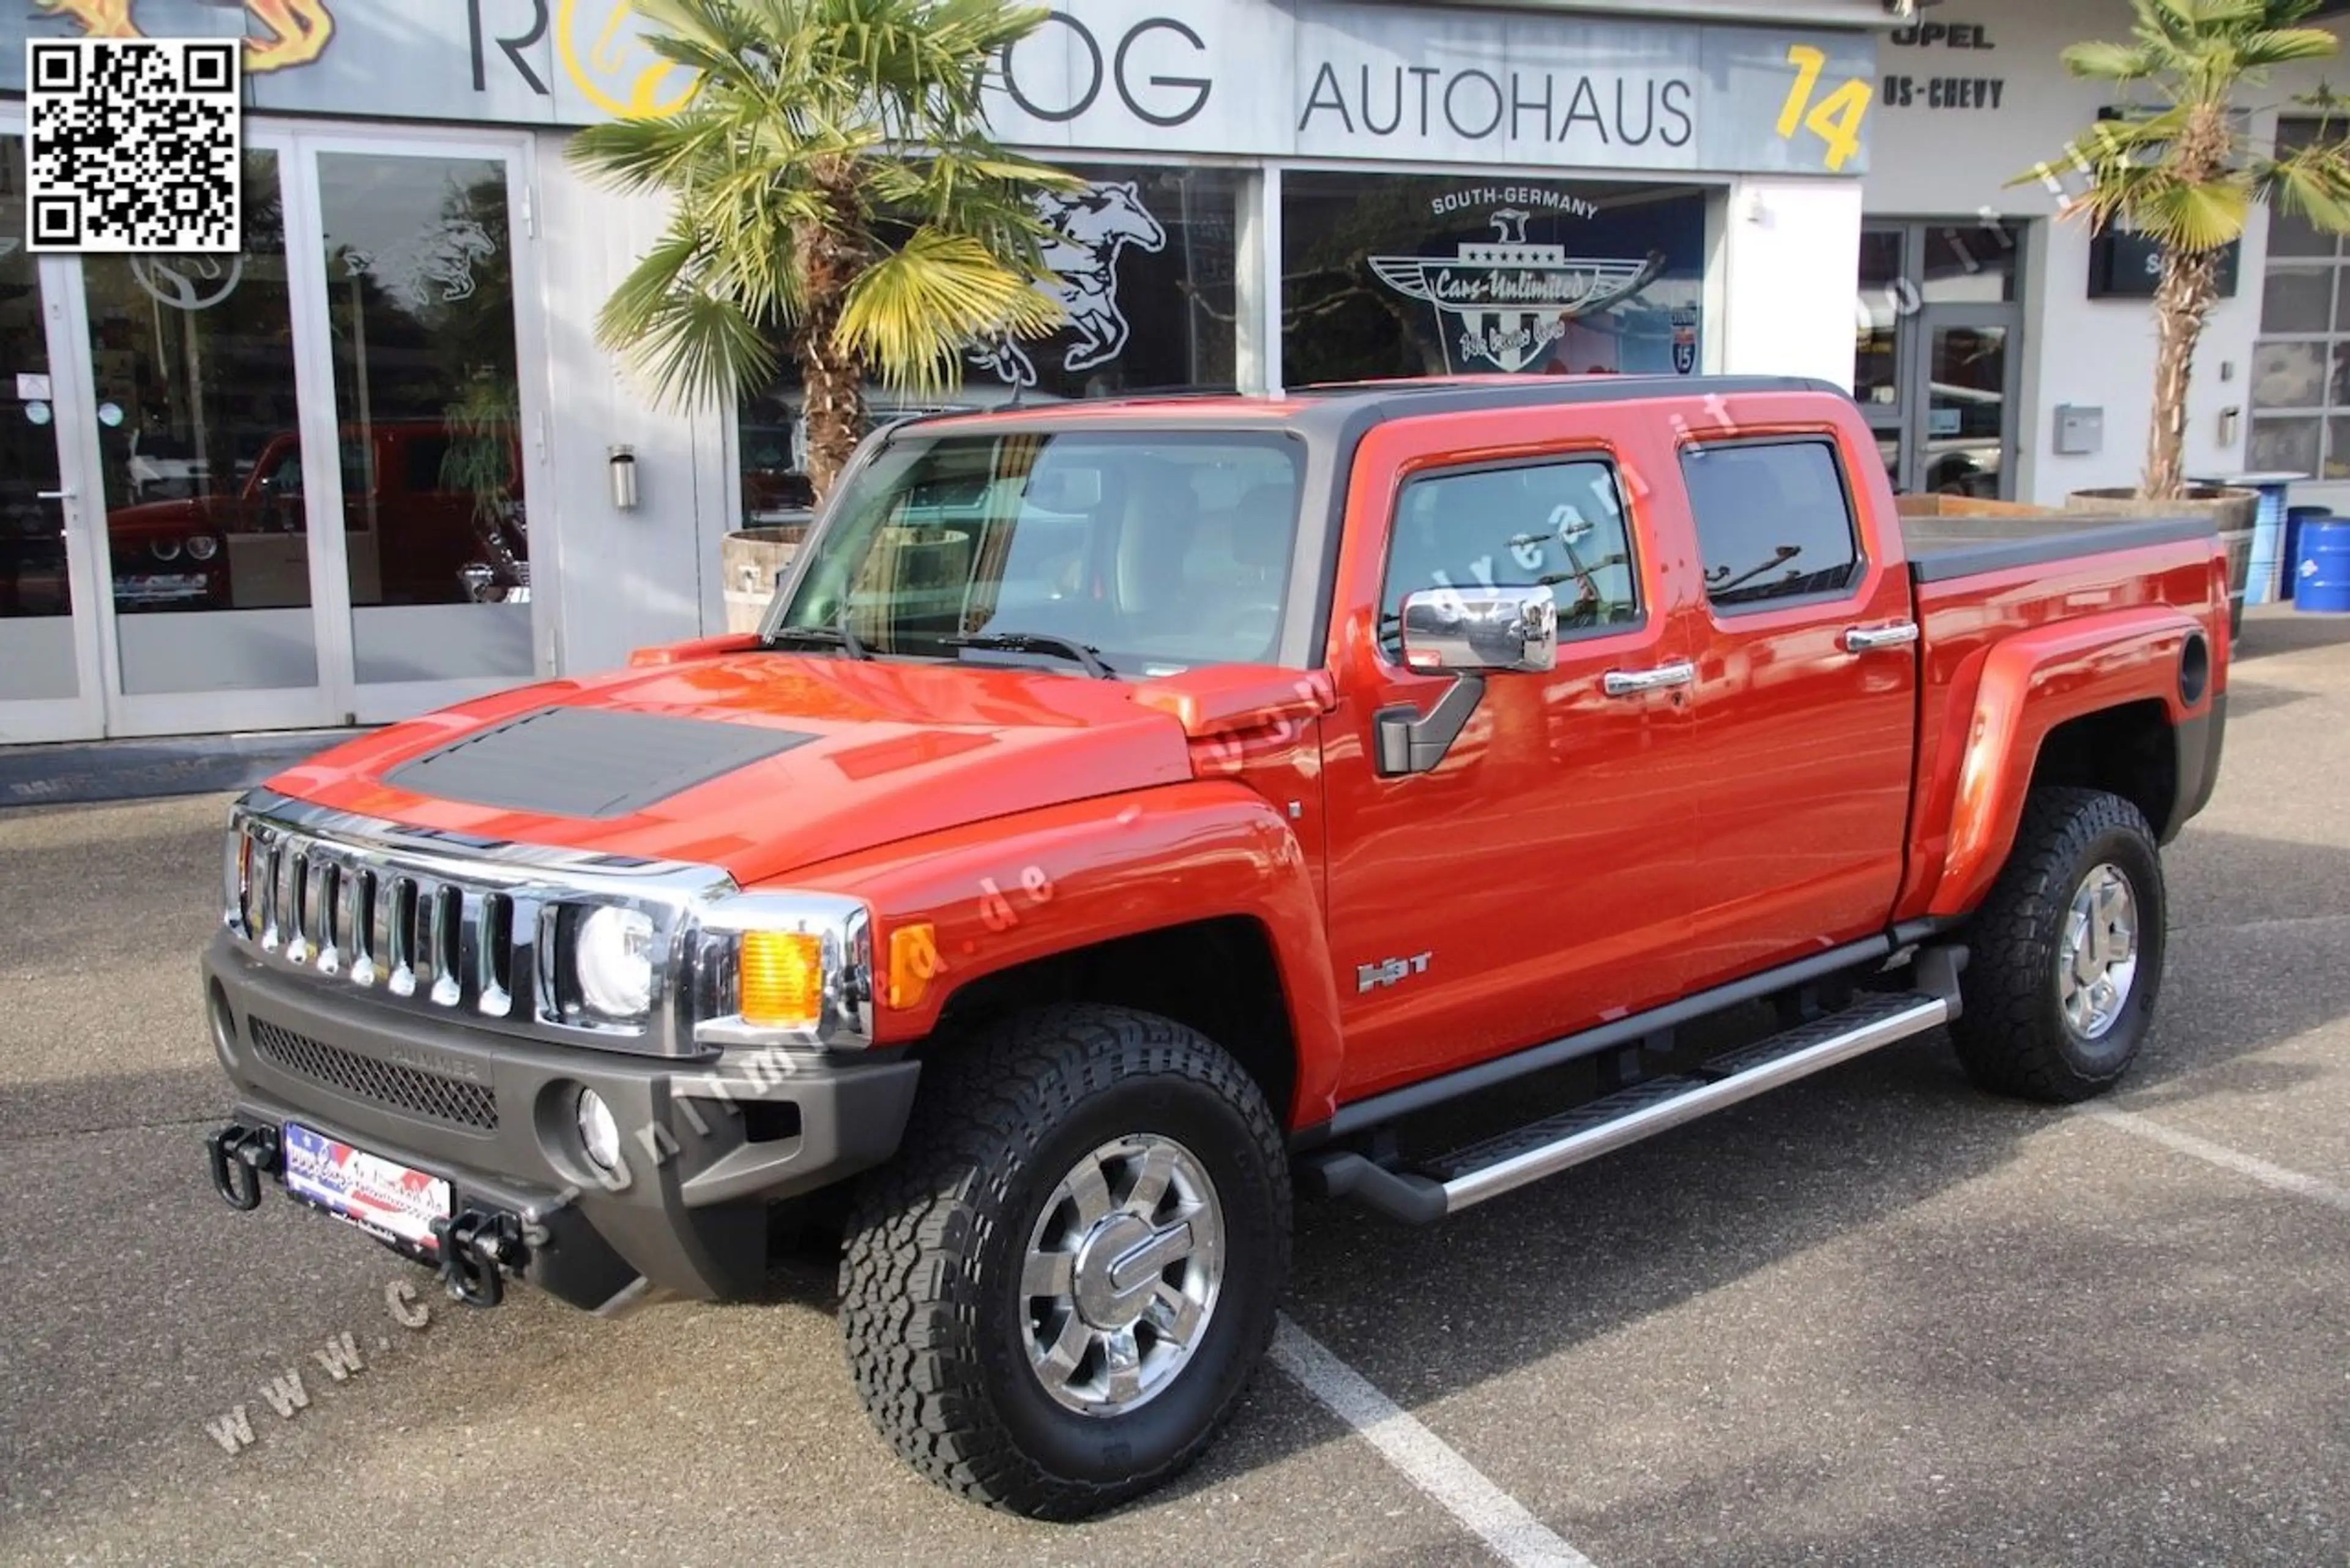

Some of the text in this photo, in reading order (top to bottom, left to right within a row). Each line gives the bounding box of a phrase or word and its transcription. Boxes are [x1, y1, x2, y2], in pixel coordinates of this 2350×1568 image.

[1891, 21, 1996, 50] OPEL
[1299, 62, 1691, 147] AUTOHAUS
[1778, 46, 1871, 170] 14
[1883, 75, 2004, 109] US-CHEVY
[1431, 186, 1598, 220] SOUTH-GERMANY
[1437, 267, 1584, 301] Cars-Unlimited
[1677, 347, 1691, 369] 15
